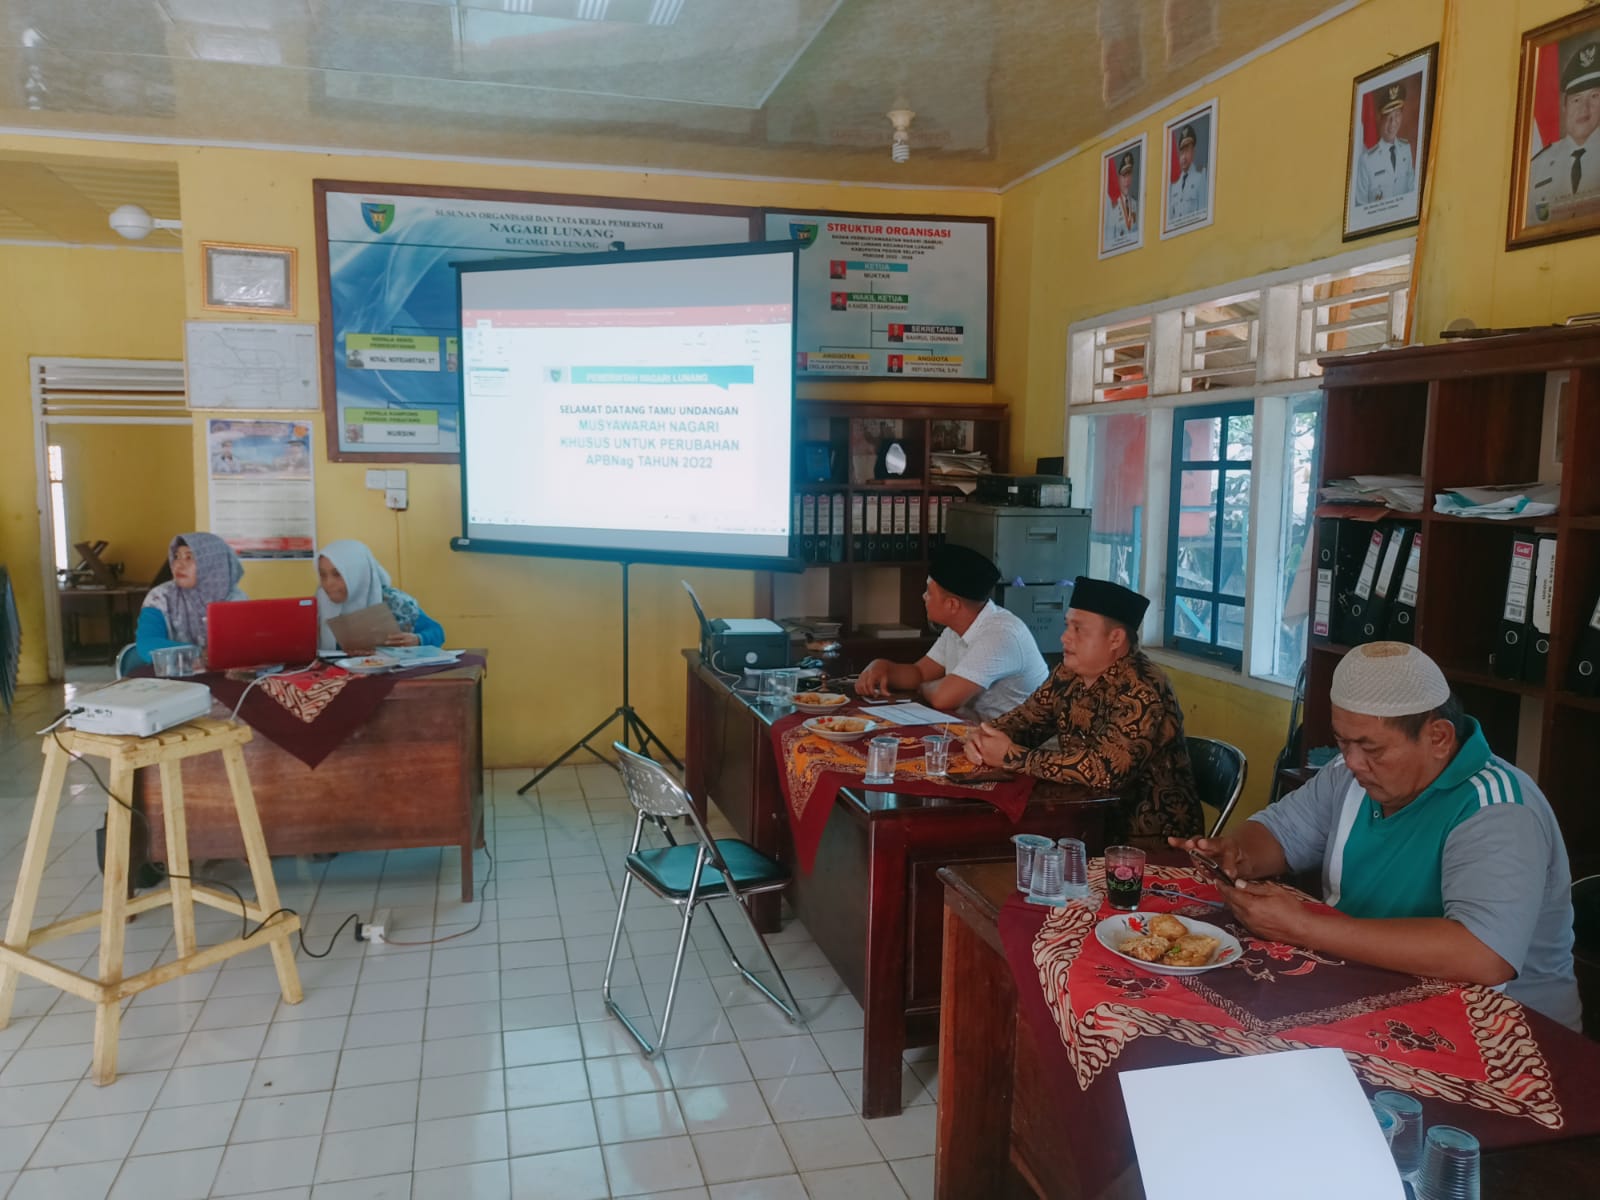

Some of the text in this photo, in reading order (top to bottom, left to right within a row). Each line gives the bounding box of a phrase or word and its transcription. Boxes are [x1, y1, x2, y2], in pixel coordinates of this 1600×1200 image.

[435, 209, 664, 229] SUSUNAN ORGANISASI DAN TATA KERJA PEMERINTAH
[490, 223, 614, 239] NAGARI LUNANG
[827, 222, 951, 238] STRUKTUR ORGANISASI
[505, 237, 599, 250] KECAMATAN LUNANG
[864, 263, 890, 271] KETUA
[911, 325, 957, 334] SEKRETARIS
[559, 404, 739, 416] SELAMAT DATANG TAMU UNDANGAN
[578, 419, 720, 433] MUSYAWARAH NAGARI
[559, 436, 740, 451] KHUSUS UNTUK PERUBAHAN
[585, 454, 713, 469] APBNag TAHUN 2022
